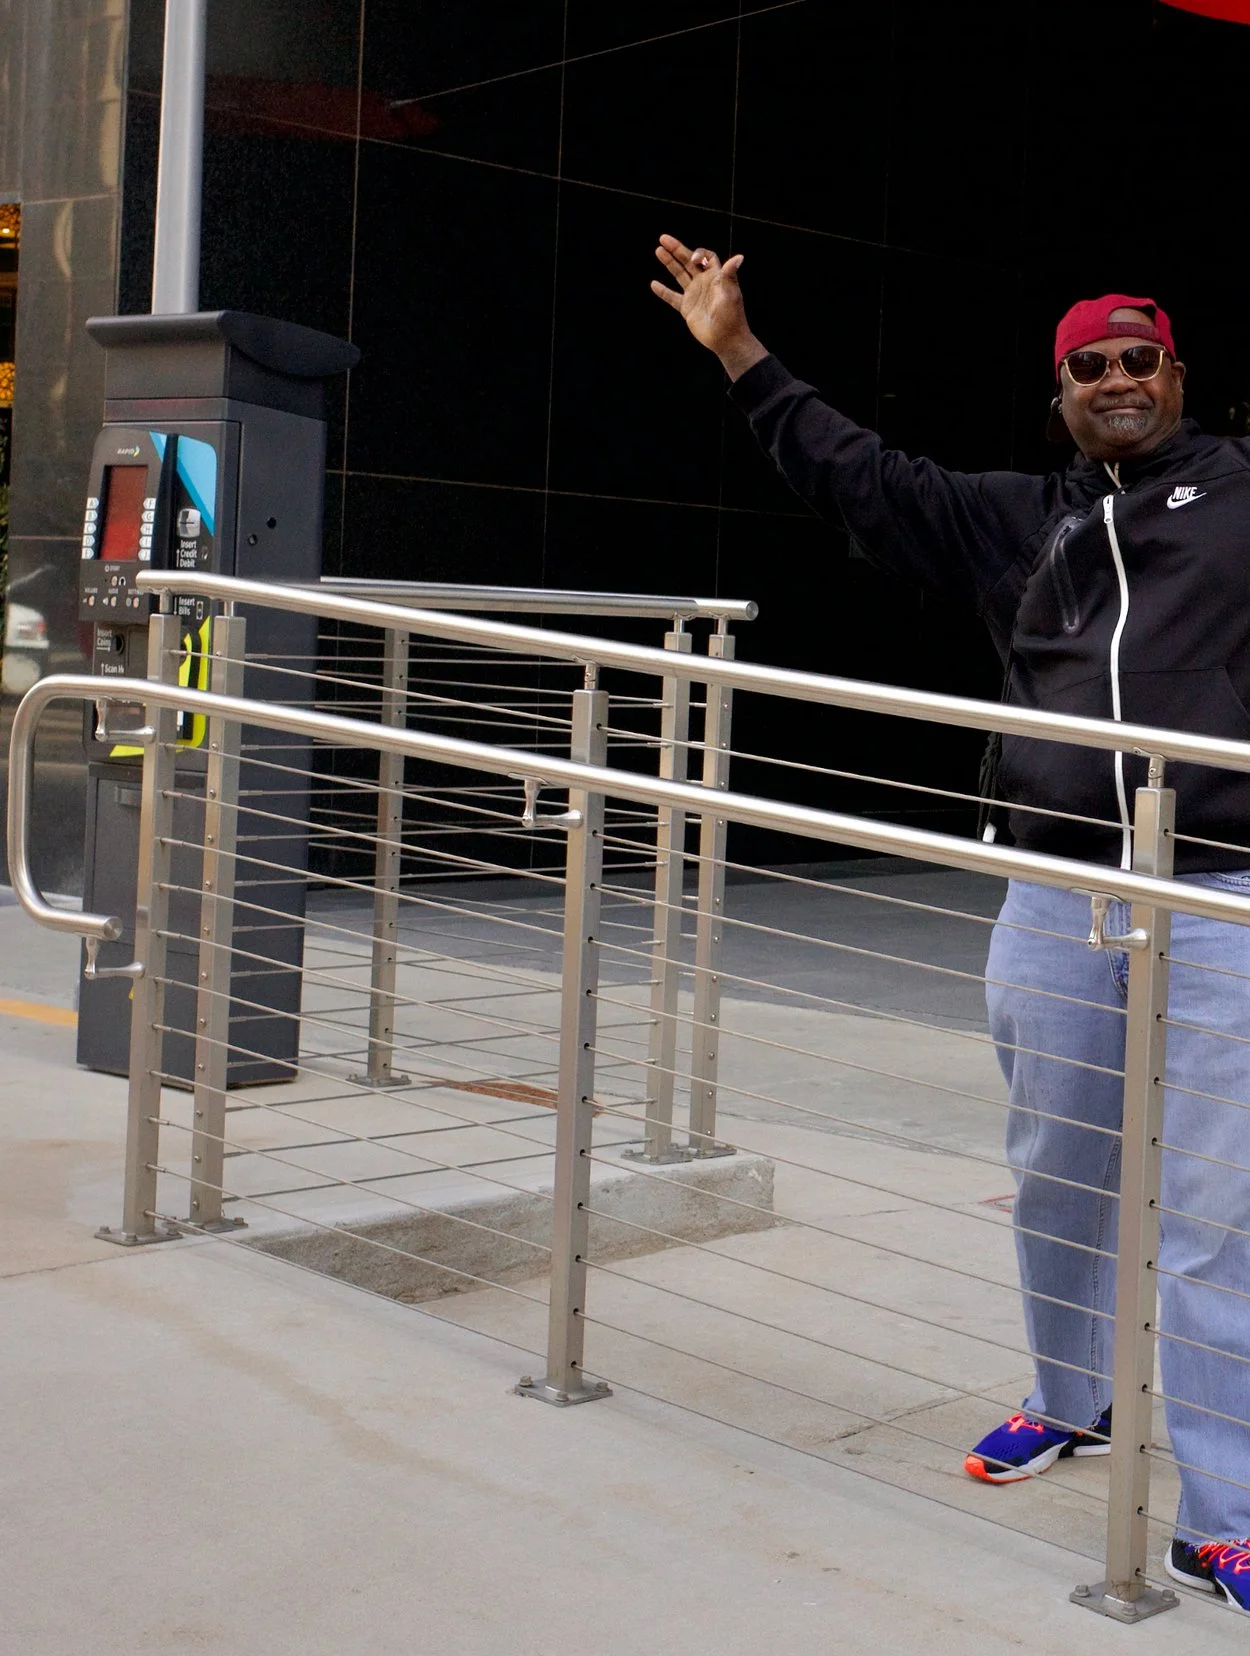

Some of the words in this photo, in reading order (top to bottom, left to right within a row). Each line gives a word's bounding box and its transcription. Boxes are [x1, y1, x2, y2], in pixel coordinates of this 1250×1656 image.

[1172, 486, 1198, 500] NIKE
[180, 540, 197, 549] Insert
[180, 549, 198, 559] Credit
[180, 559, 195, 568] Debit
[179, 597, 195, 606] Insert
[178, 606, 191, 616] Bills
[97, 628, 112, 637] Insert
[104, 663, 118, 674] Scan
